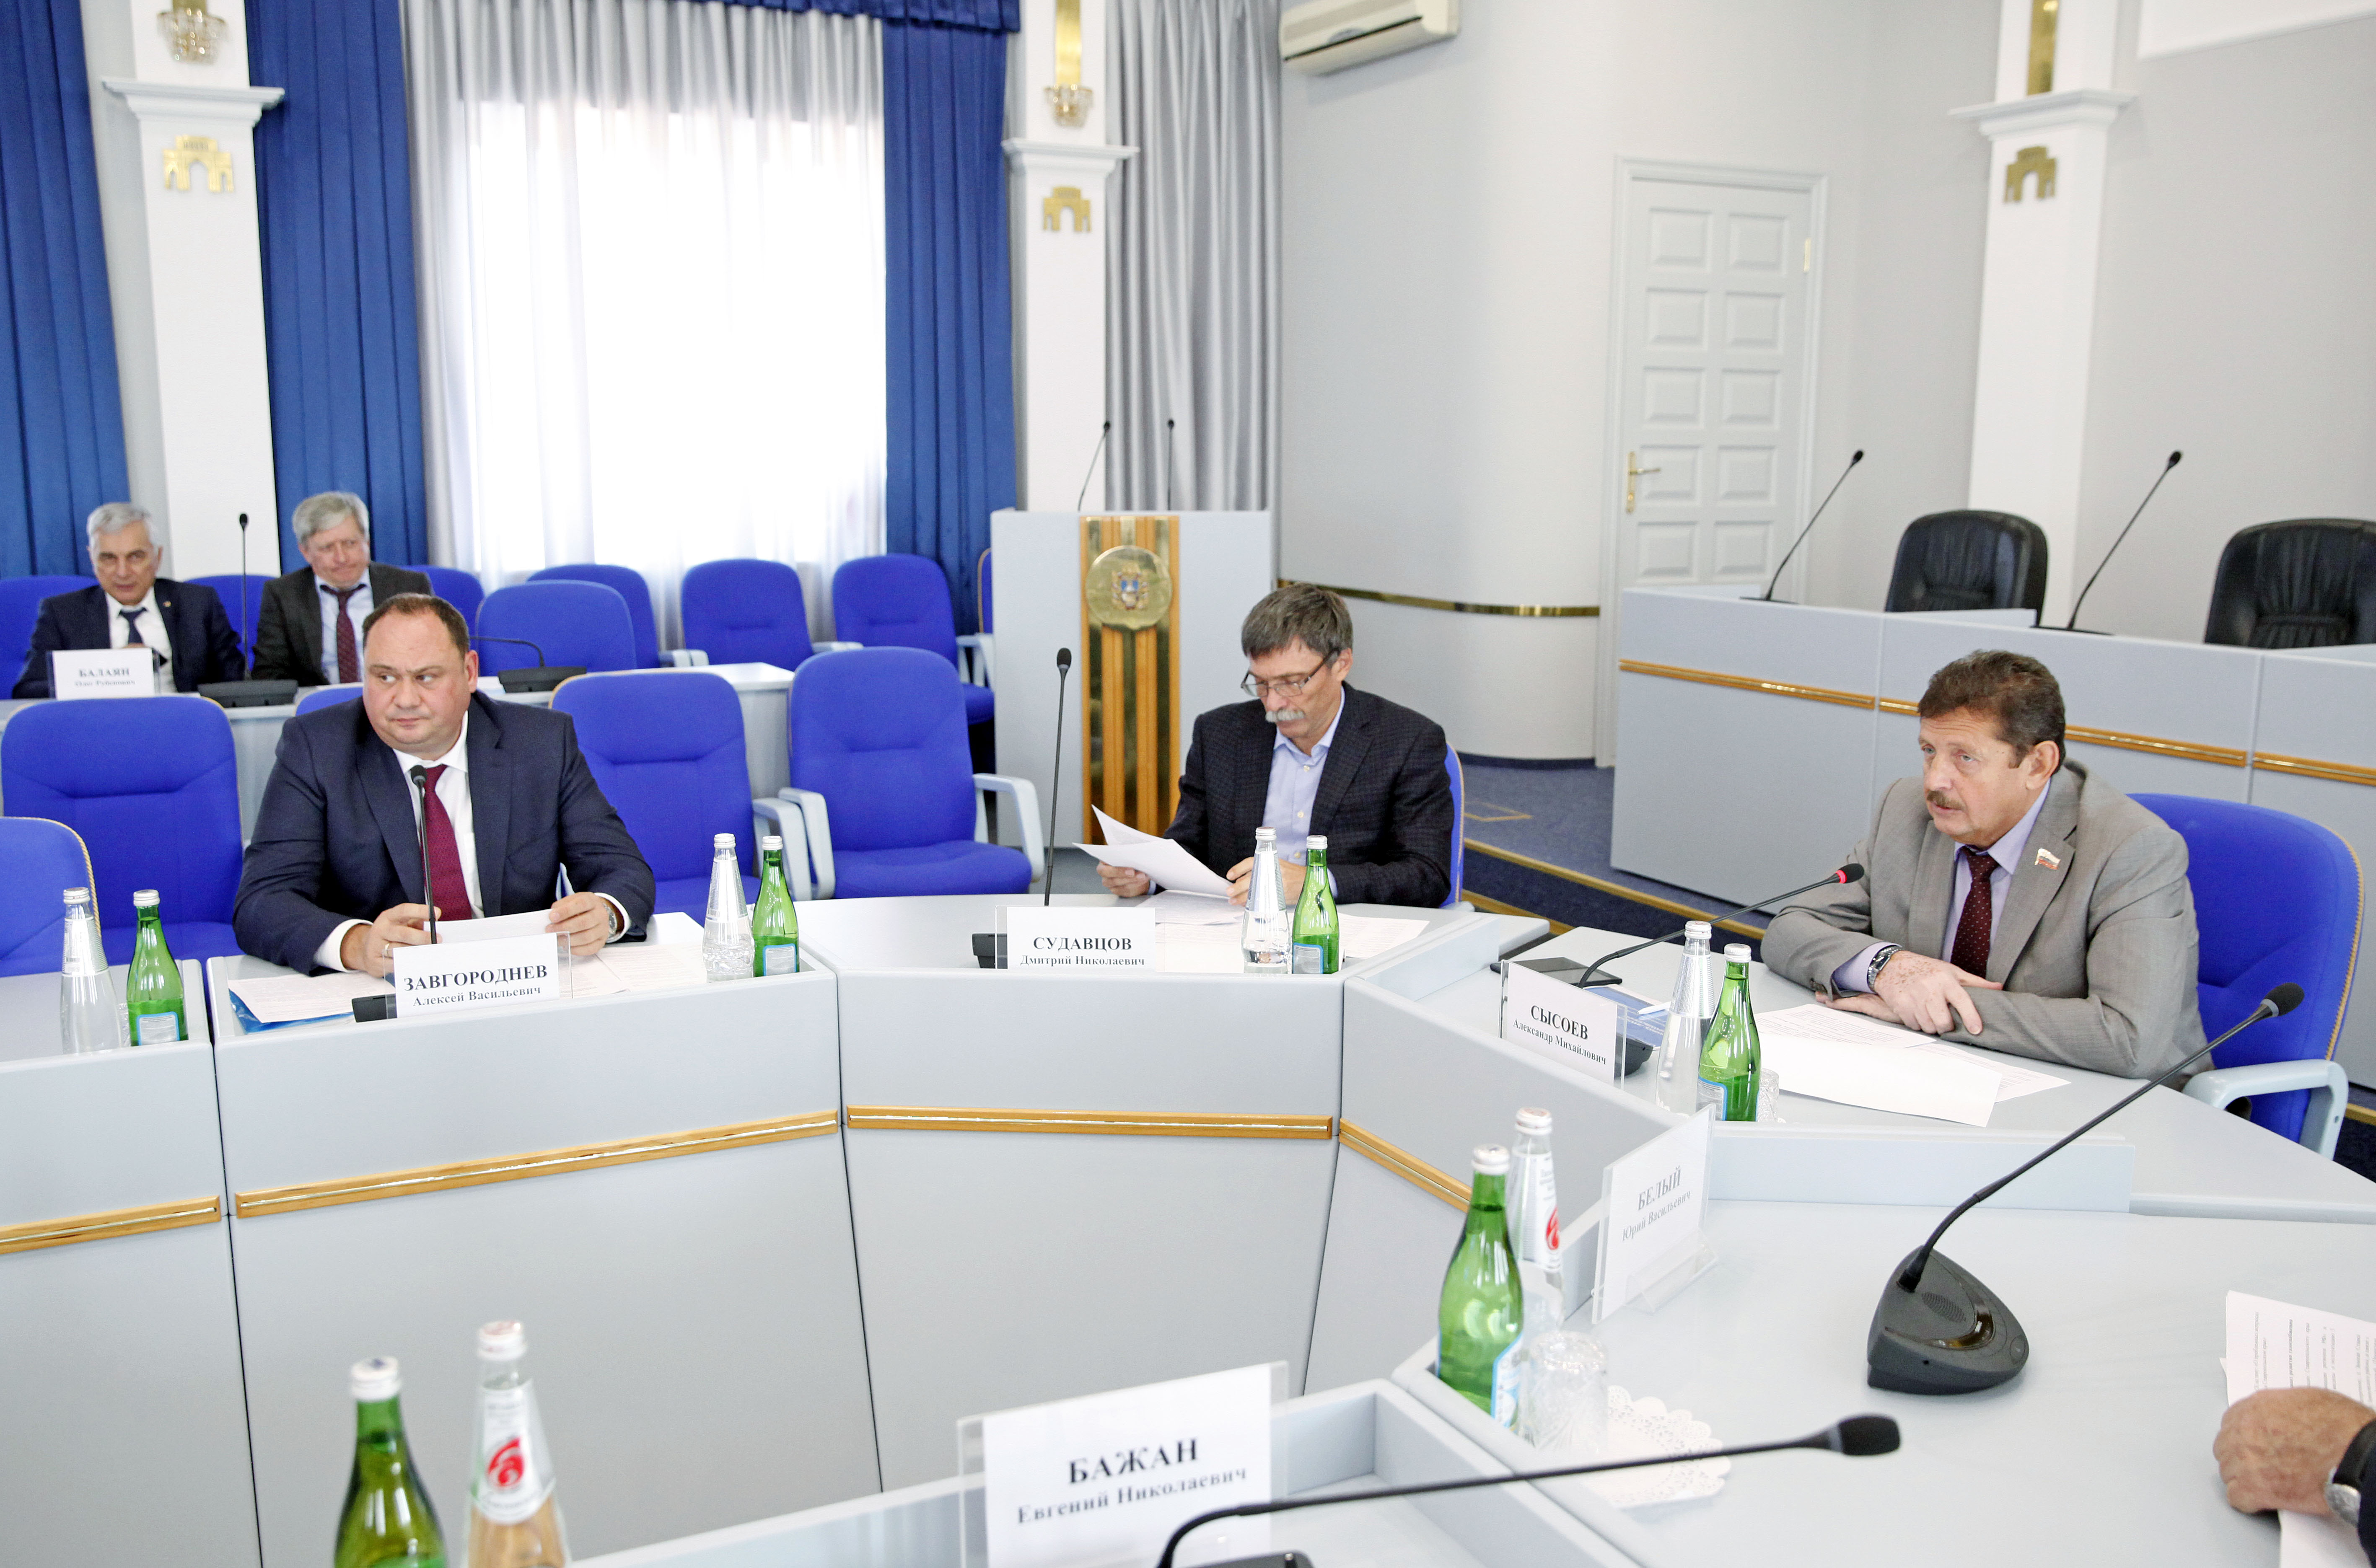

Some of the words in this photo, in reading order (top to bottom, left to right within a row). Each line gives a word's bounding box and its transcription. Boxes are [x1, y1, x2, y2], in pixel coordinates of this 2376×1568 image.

[79, 668, 129, 677] БАЛАЯН
[1021, 956, 1070, 966] Дмитрий
[1076, 956, 1144, 965] Николаевич
[1034, 937, 1131, 952] СУДАВЦОВ
[404, 965, 547, 991] ЗАВГОРОДНЕВ
[413, 993, 464, 1006] Алексей
[469, 988, 540, 1000] Васильевич
[1531, 1006, 1588, 1039] СЫСОЕВ
[1513, 1019, 1552, 1044] Александр
[1555, 1035, 1606, 1065] Михайлович
[1638, 1166, 1681, 1211] БЕЛЫЙ
[1623, 1217, 1645, 1241] Юрий
[1648, 1191, 1690, 1224] Васильевич
[1070, 1439, 1196, 1484] БАЖАН
[1018, 1495, 1108, 1524] Евгений
[1118, 1470, 1245, 1504] Николаевич
